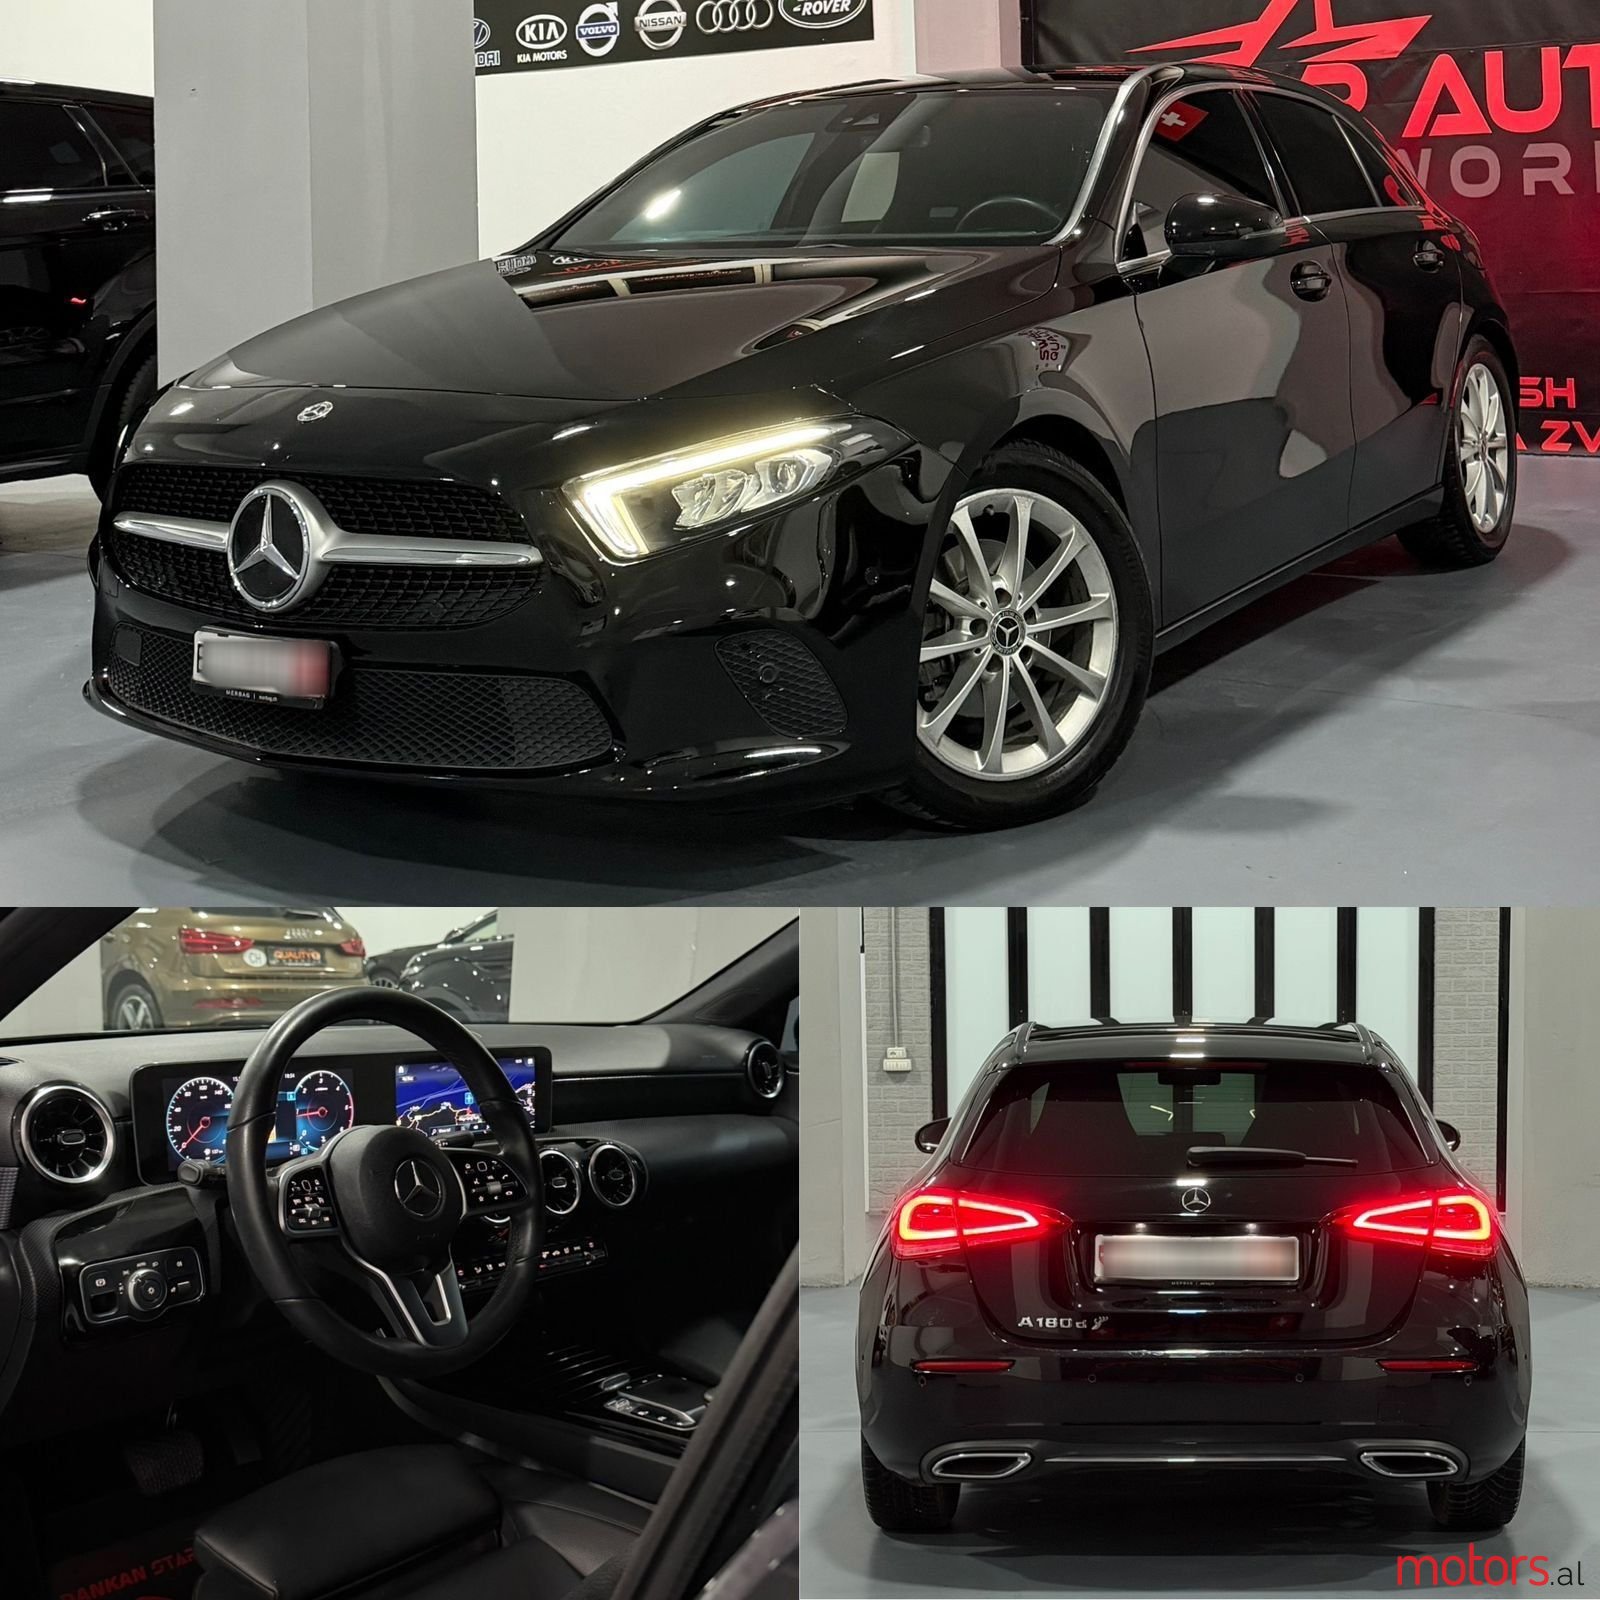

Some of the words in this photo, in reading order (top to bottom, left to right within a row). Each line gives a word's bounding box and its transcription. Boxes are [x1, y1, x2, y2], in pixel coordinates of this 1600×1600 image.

[639, 14, 683, 28] NISSAN
[524, 22, 561, 42] KIA
[579, 25, 617, 36] VOLVO
[517, 53, 531, 64] KIA
[533, 50, 568, 62] MOTORS
